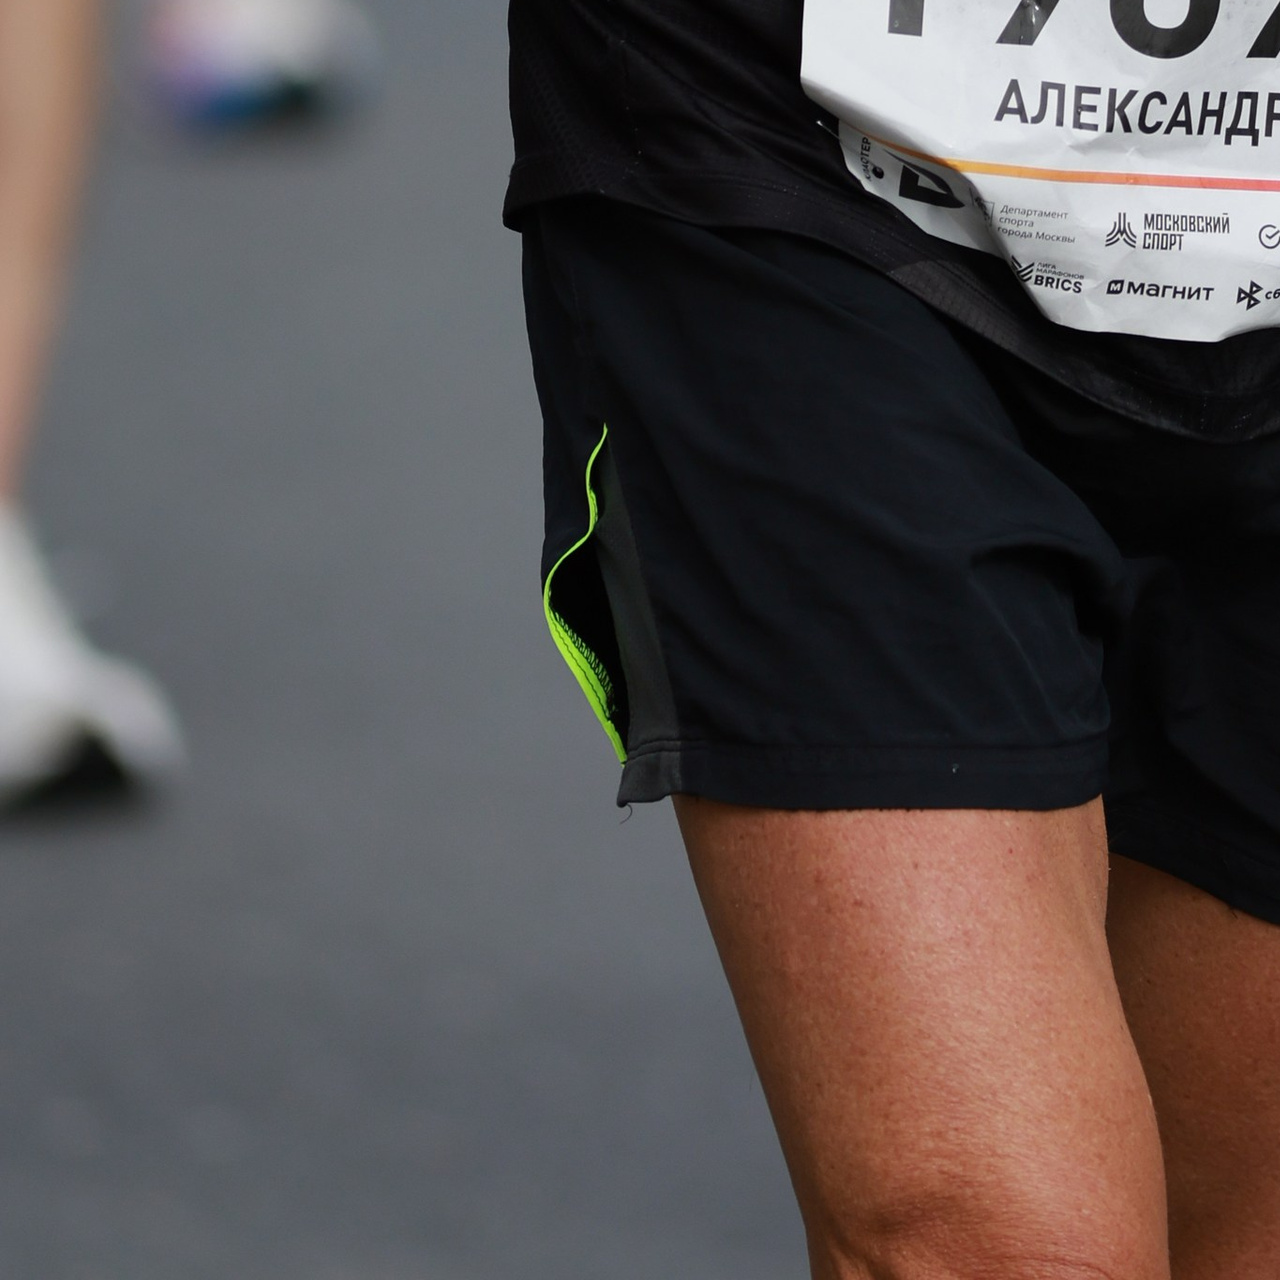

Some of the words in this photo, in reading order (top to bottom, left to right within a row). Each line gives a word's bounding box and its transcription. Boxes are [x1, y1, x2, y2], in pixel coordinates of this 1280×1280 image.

[1000, 205, 1068, 219] Департамент
[999, 217, 1034, 228] спорта
[1143, 212, 1230, 234] МОСКОВСКИЙ
[997, 226, 1033, 239] города
[1035, 231, 1076, 243] Москвы
[1142, 233, 1184, 251] СПОРТ
[1034, 274, 1083, 294] BRICS
